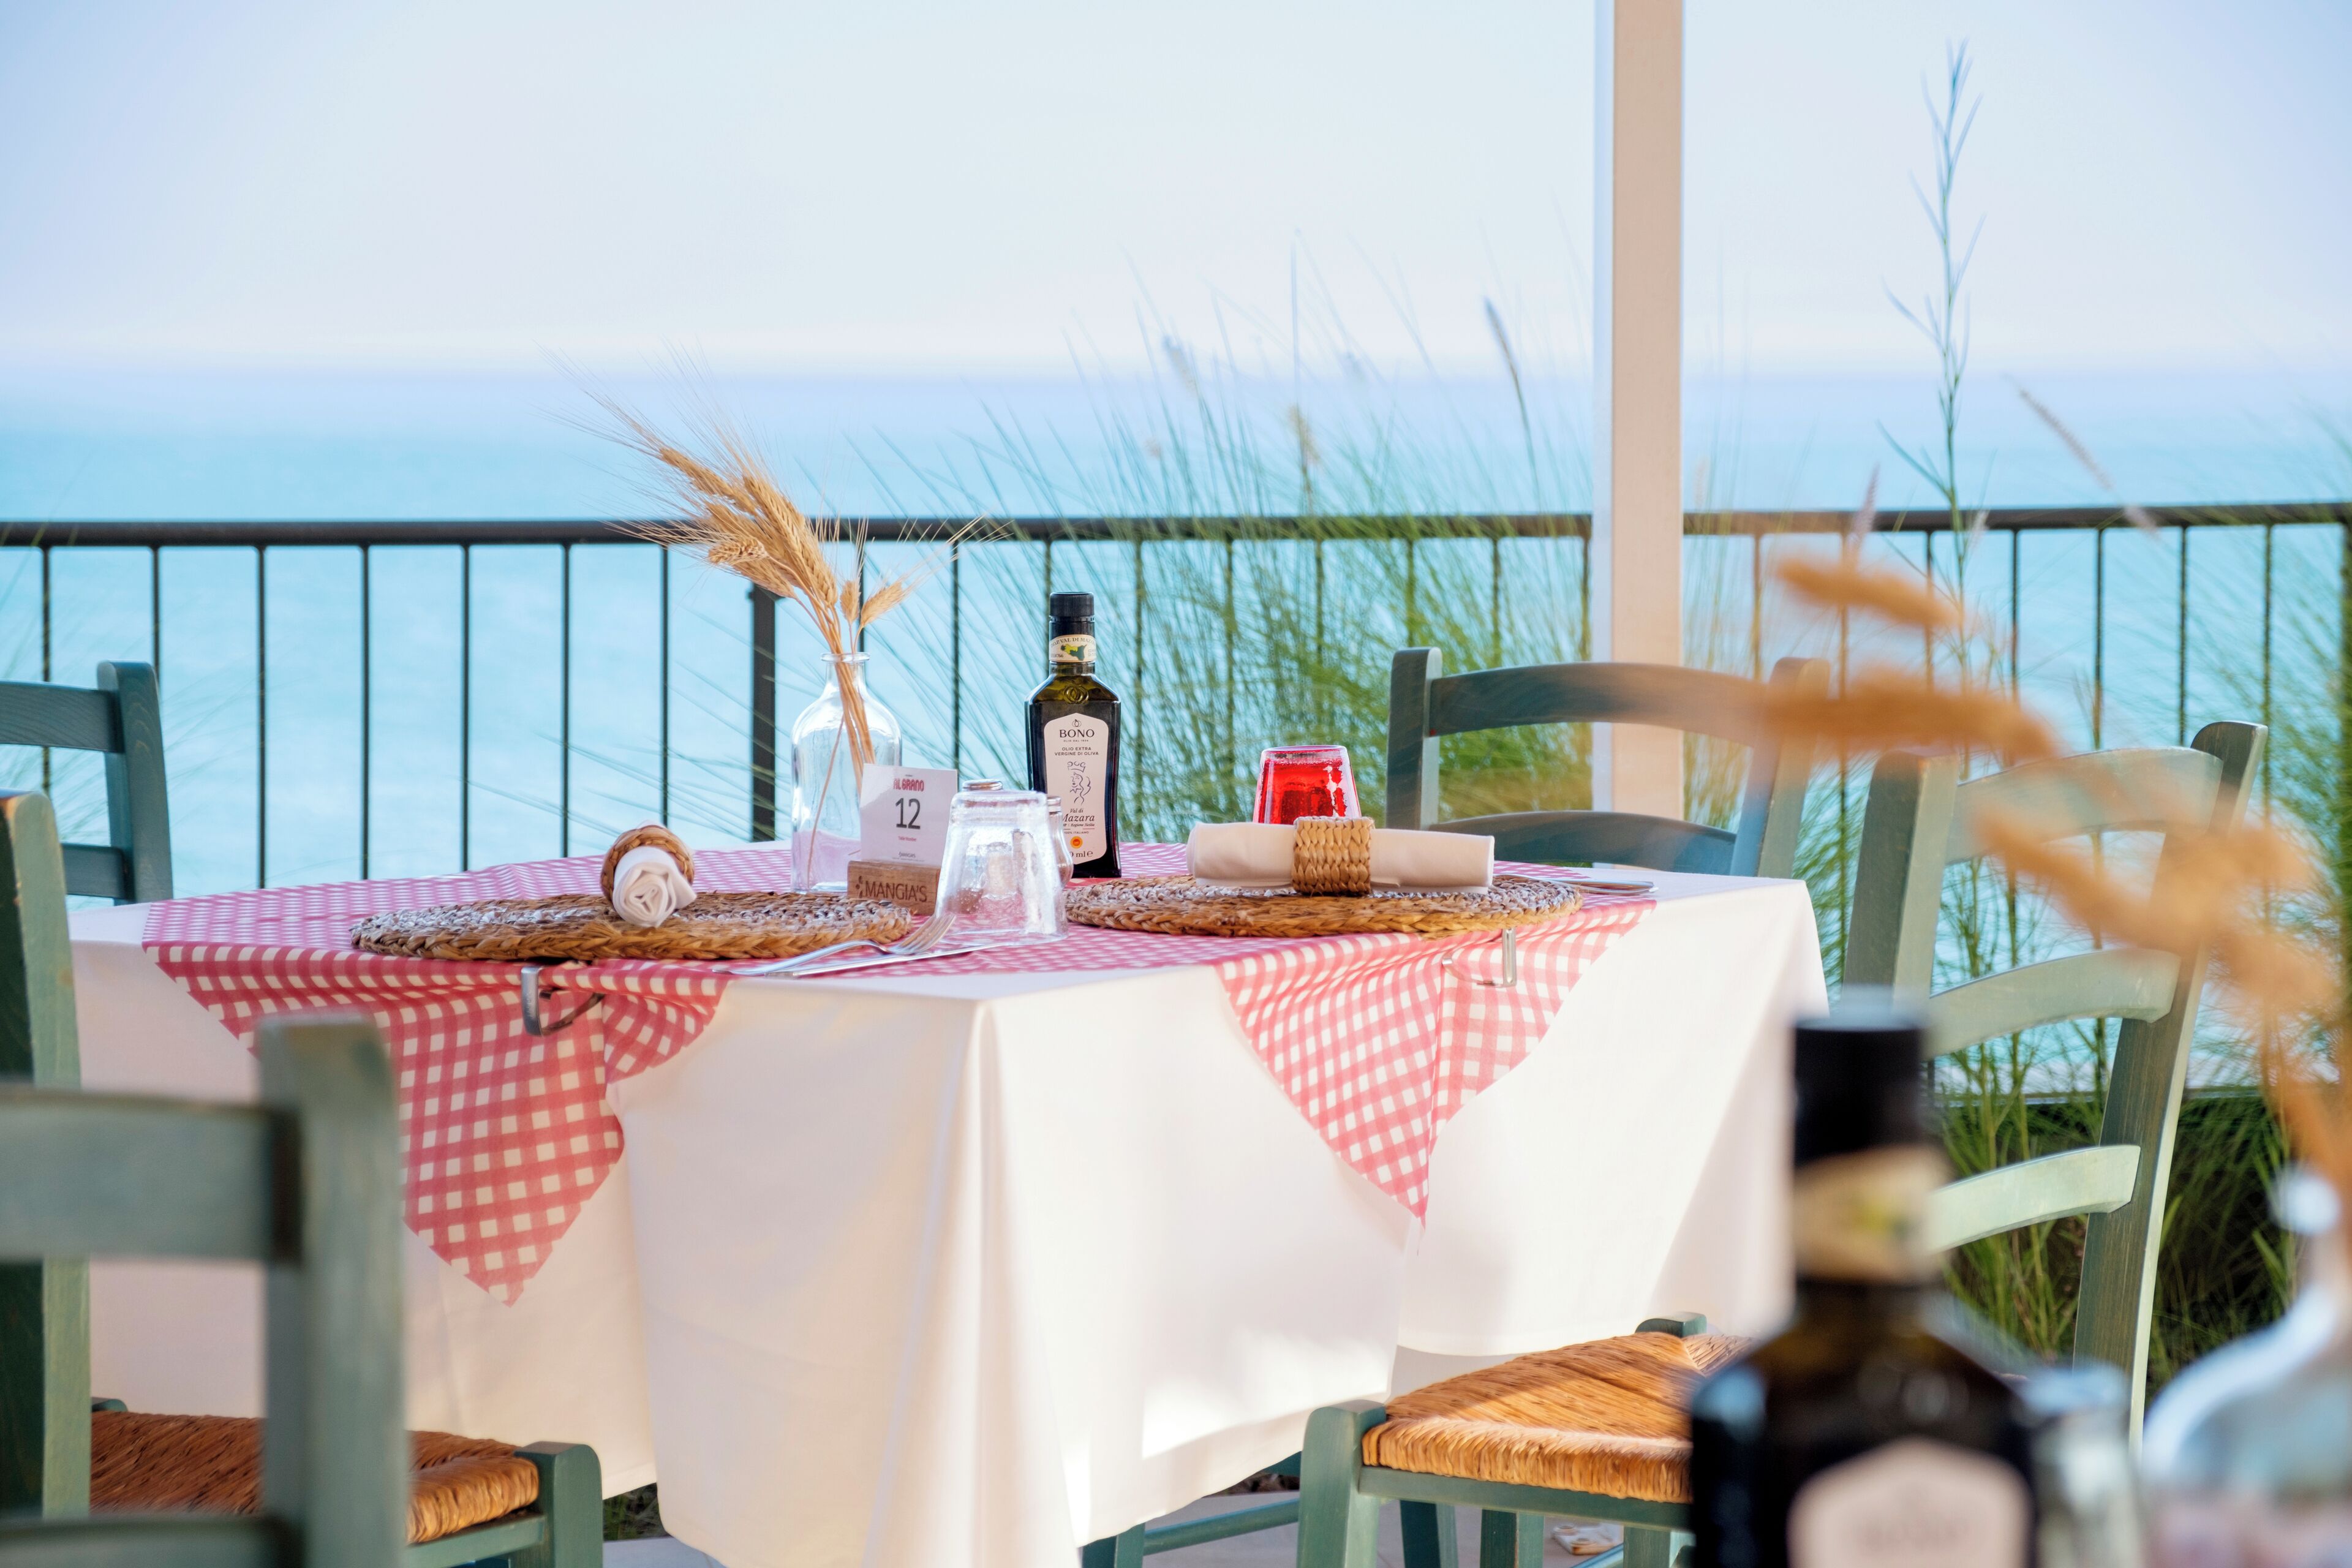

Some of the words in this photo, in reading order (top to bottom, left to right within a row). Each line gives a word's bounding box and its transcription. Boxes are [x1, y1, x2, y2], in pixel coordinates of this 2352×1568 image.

[1060, 729, 1095, 737] BONO
[902, 778, 924, 792] GRANO
[895, 797, 921, 829] 12
[865, 880, 927, 903] MANGIA'S
